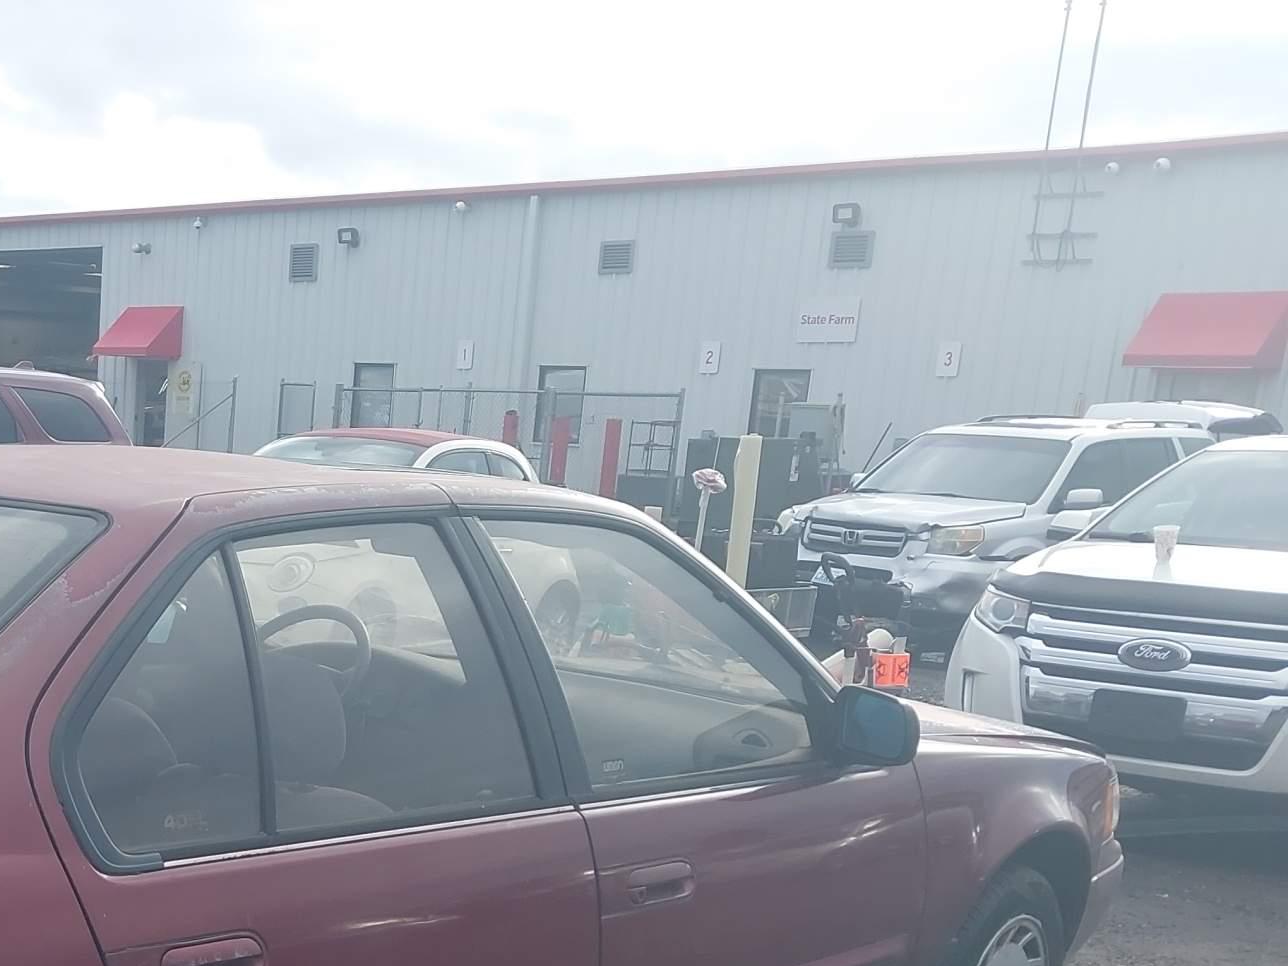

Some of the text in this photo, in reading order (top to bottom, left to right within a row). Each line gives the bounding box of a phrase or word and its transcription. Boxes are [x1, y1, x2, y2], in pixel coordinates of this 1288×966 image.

[801, 314, 855, 325] State Farm
[705, 350, 714, 364] 2
[943, 351, 953, 367] 3
[1134, 644, 1171, 660] Ford
